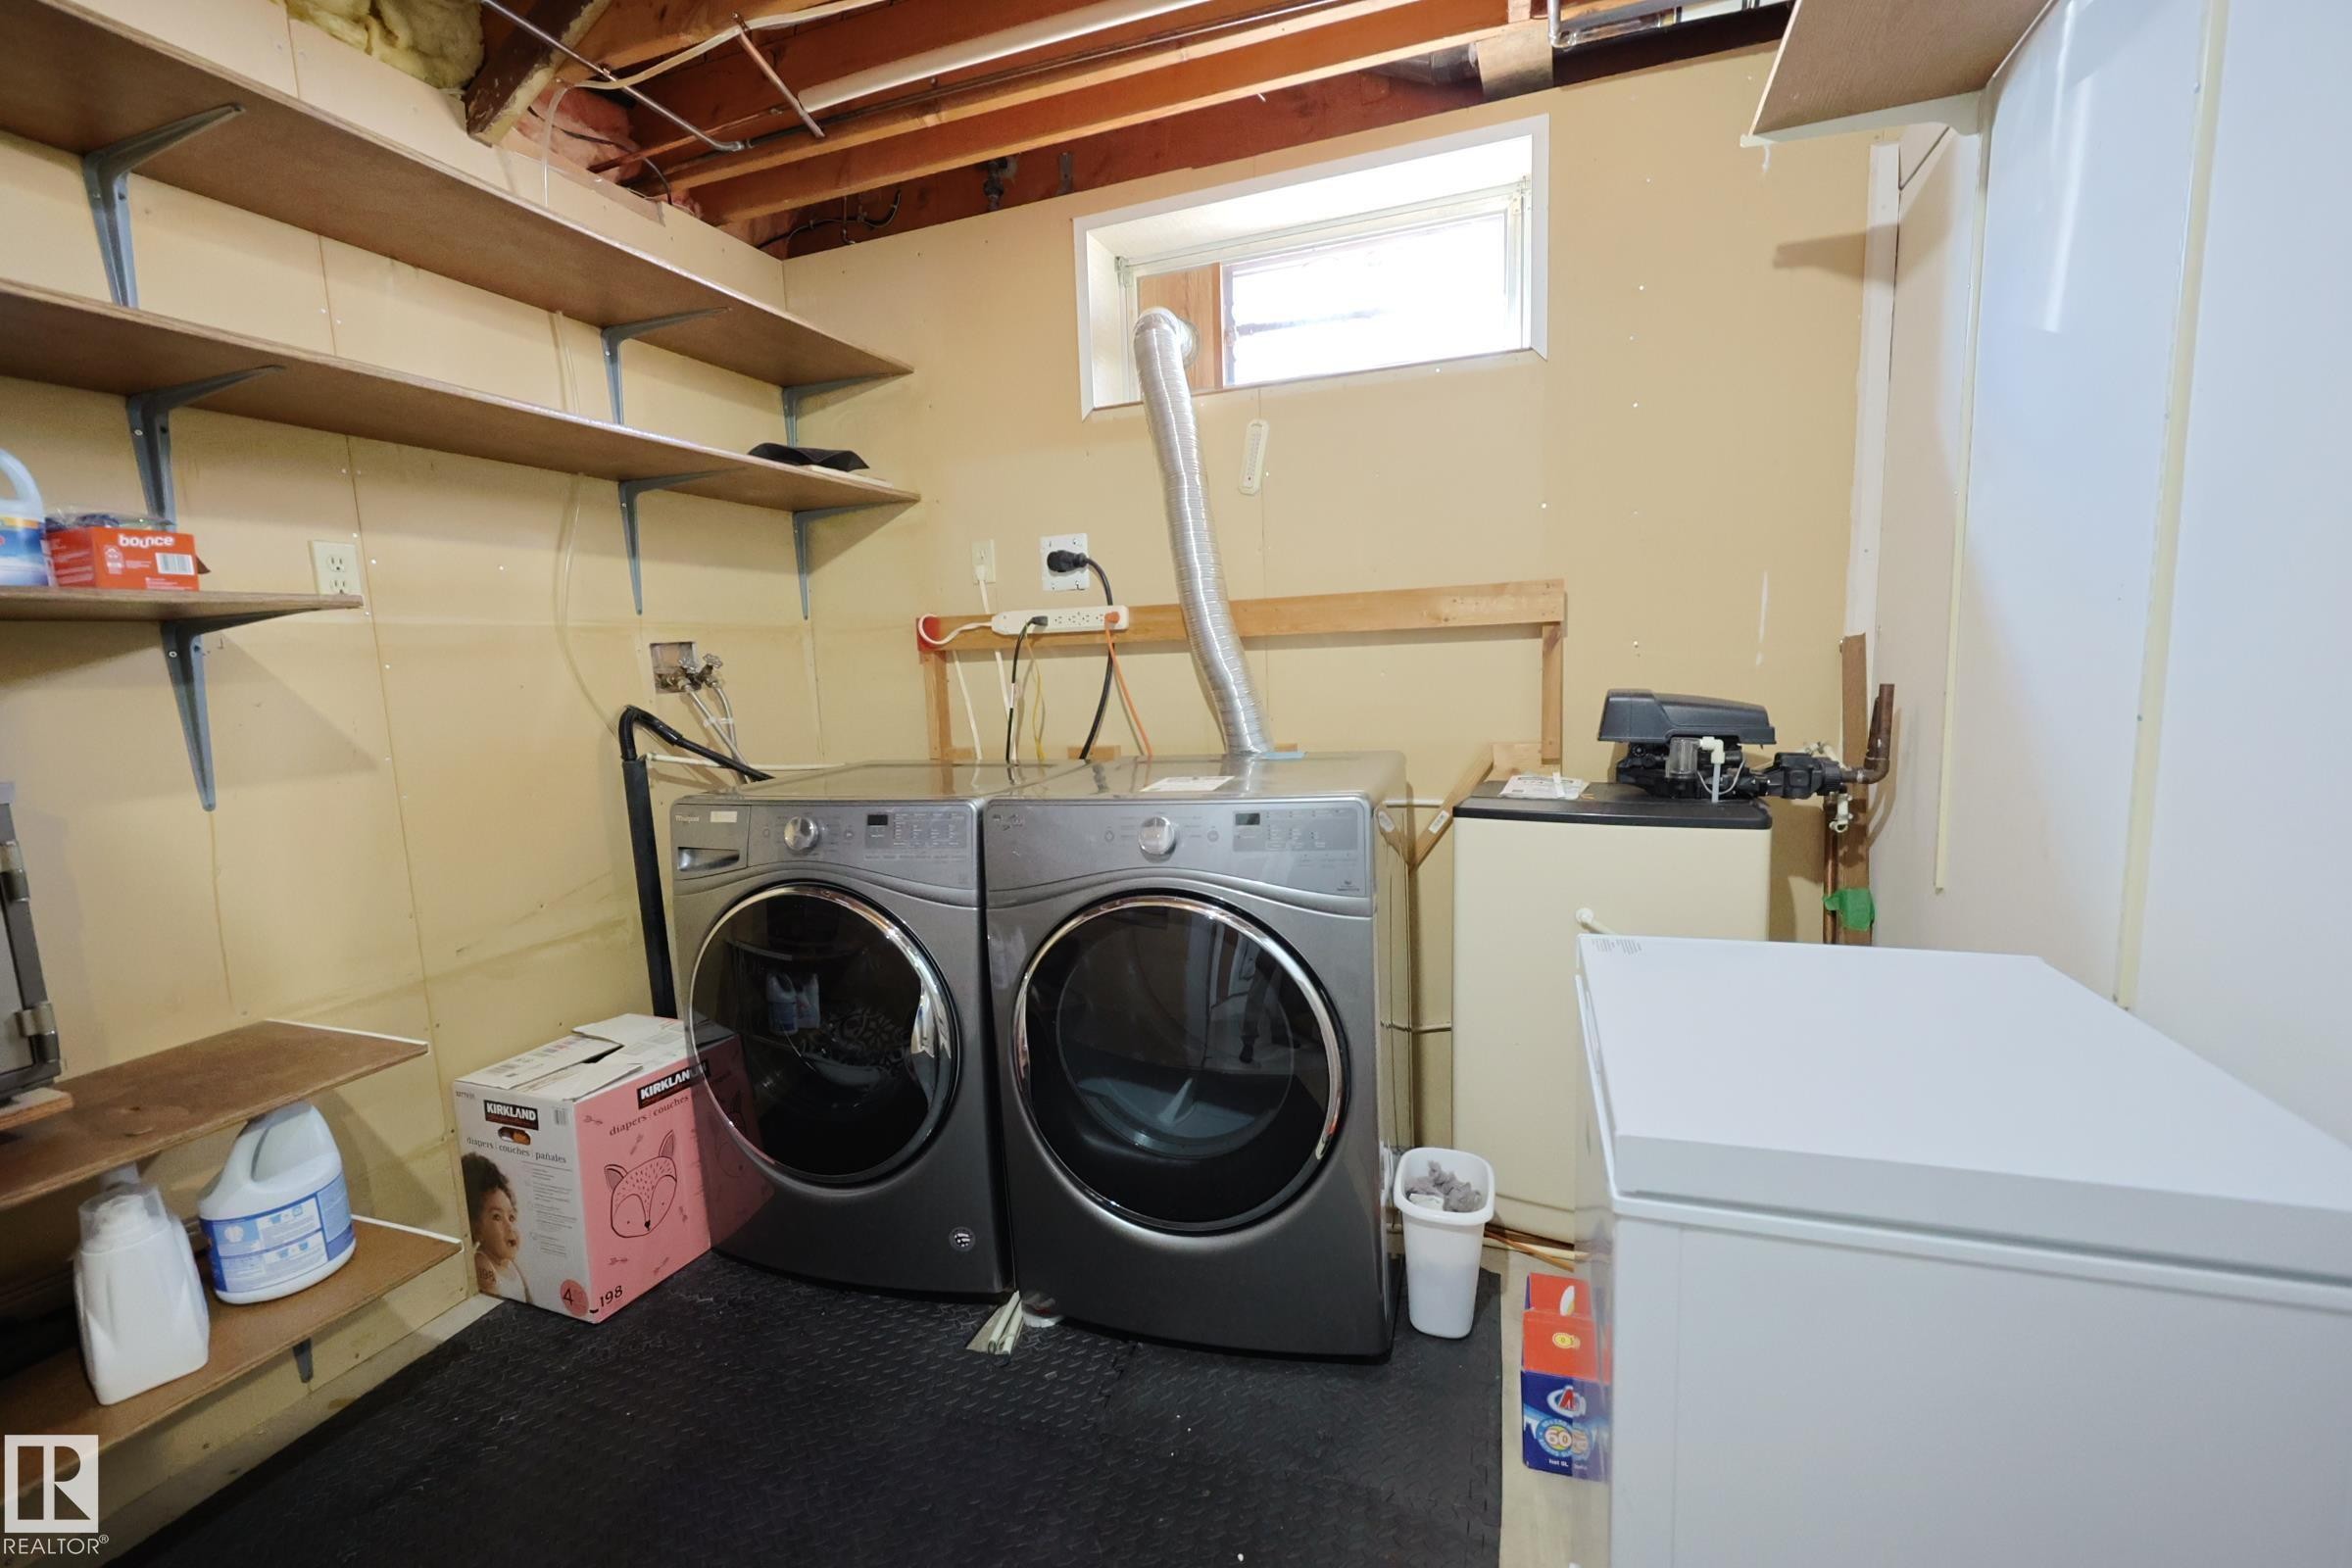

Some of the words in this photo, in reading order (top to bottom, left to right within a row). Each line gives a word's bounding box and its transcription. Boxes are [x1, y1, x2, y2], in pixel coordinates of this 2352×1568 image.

[119, 534, 174, 548] bounce
[640, 1068, 691, 1100] KIRKLAN
[486, 1102, 536, 1121] KIRKLAND
[610, 1114, 647, 1136] diapers
[654, 1097, 688, 1116] couches
[466, 1137, 494, 1149] diapers
[499, 1144, 530, 1156] couches
[563, 1288, 574, 1305] 4
[600, 1285, 623, 1307] 198
